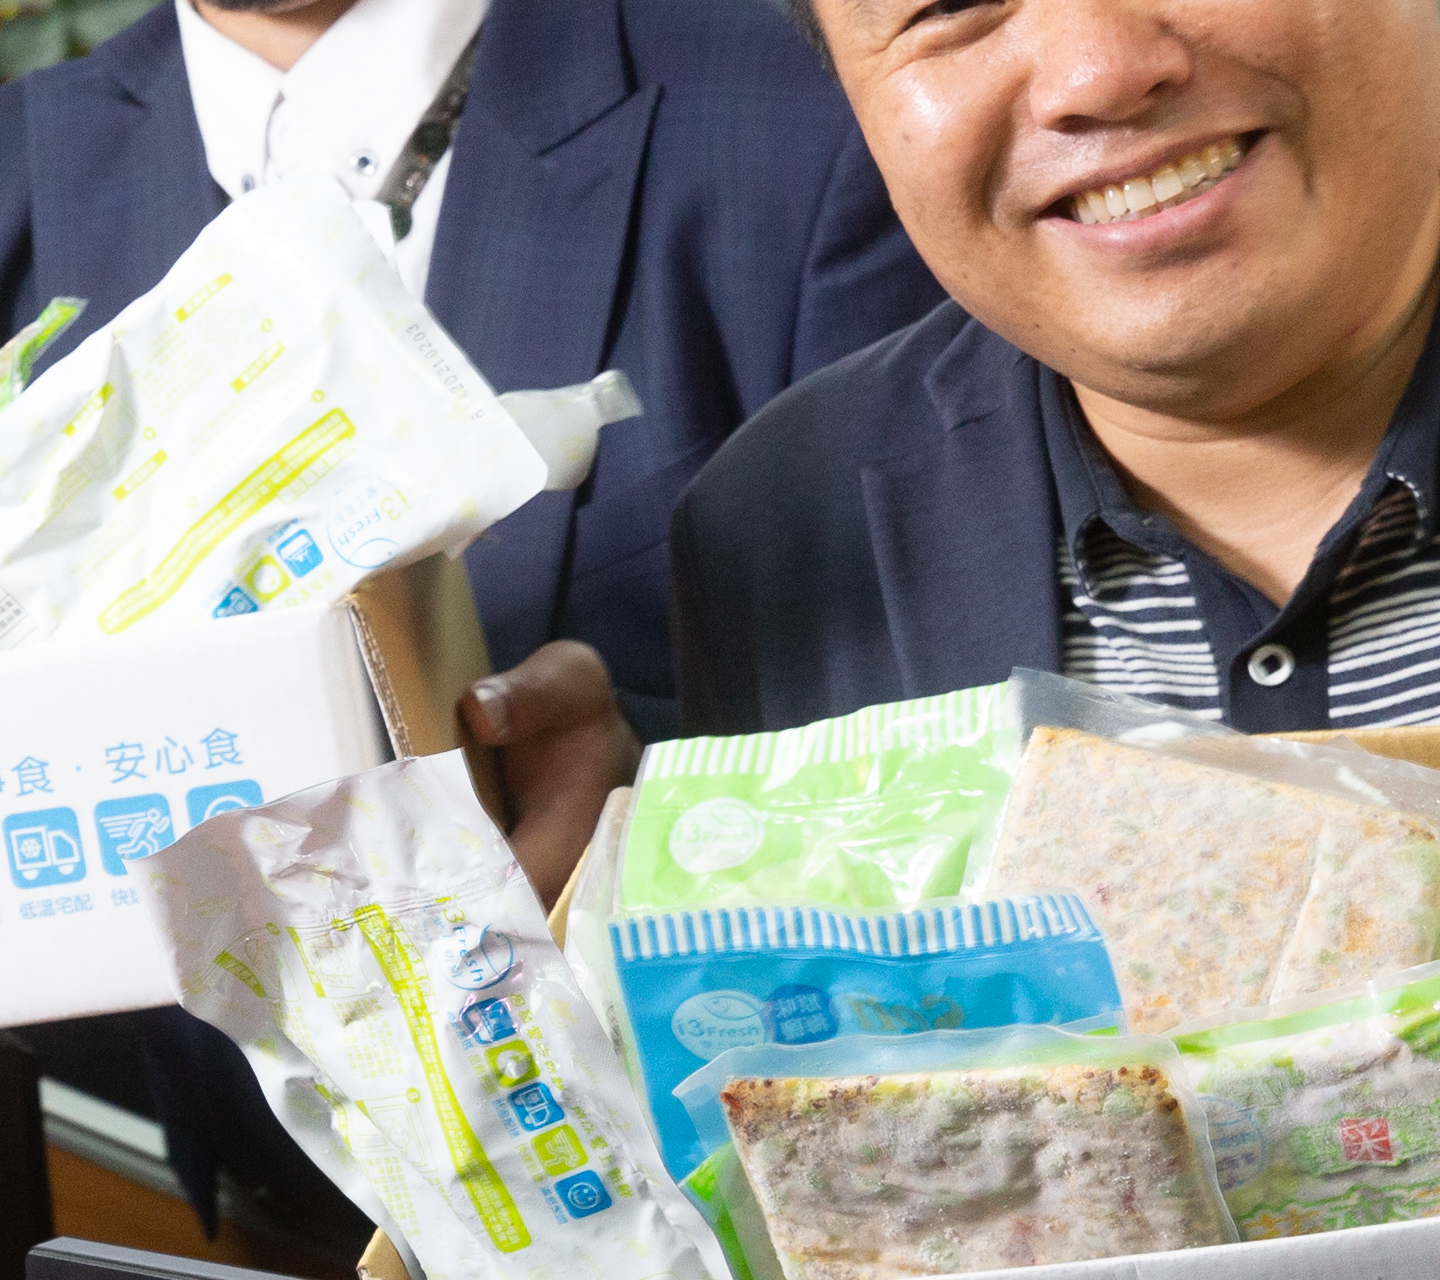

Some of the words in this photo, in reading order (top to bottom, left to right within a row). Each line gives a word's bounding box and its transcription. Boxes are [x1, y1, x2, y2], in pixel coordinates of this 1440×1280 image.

[19, 894, 93, 921] 低溫宅配
[677, 1018, 760, 1039] i3Fresh
